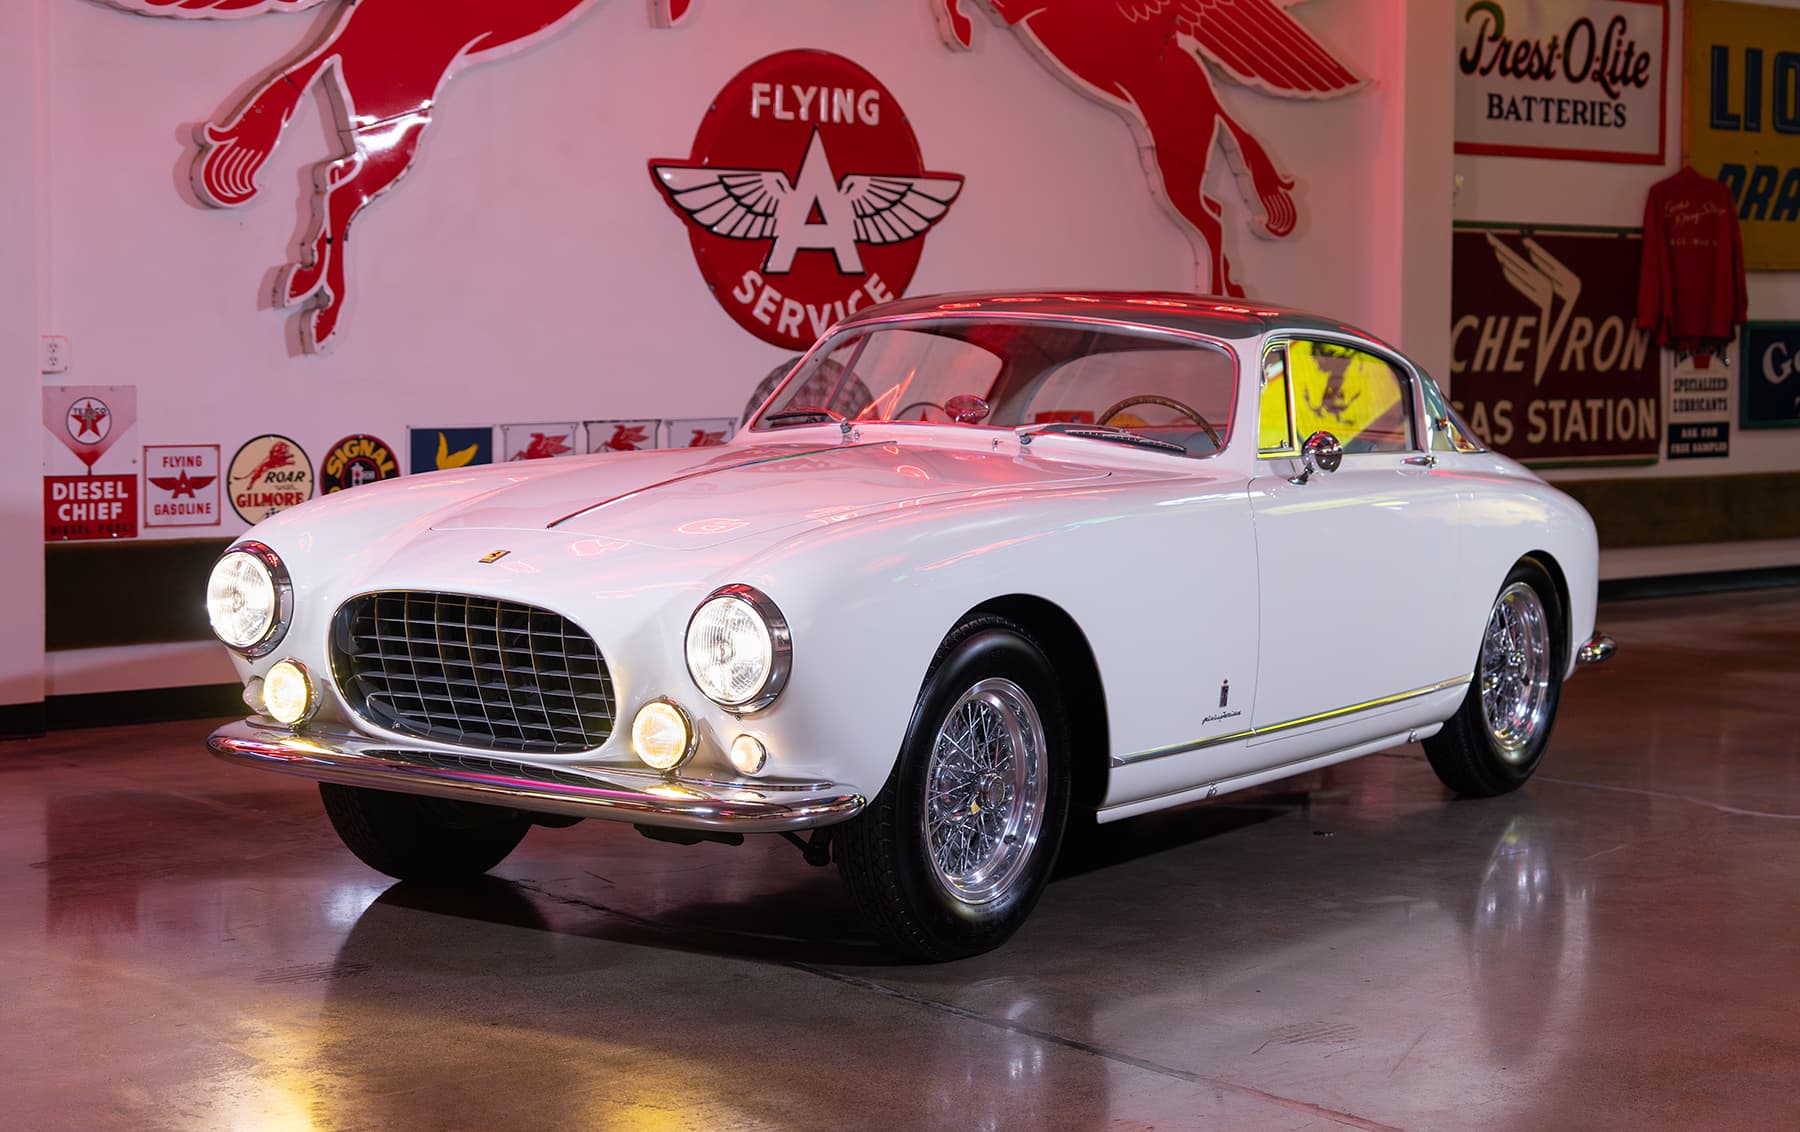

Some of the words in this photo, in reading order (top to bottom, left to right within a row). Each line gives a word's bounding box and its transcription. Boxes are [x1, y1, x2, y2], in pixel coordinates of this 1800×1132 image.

[750, 83, 881, 126] FLYING
[1486, 92, 1627, 128] BATTERIES
[764, 125, 865, 275] A
[732, 269, 894, 338] SERVICE
[1450, 312, 1653, 388] CHEVRON
[73, 407, 107, 415] TEXACO
[1452, 399, 1514, 446] AS
[1526, 396, 1657, 443] STATION
[162, 455, 203, 468] FLYING
[327, 439, 395, 479] SIGNAL
[264, 470, 306, 483] ROAR
[52, 480, 129, 501] DIESEL
[236, 492, 304, 509] GILMORE
[57, 501, 123, 522] CHIEF
[154, 502, 212, 516] GASOLINE
[50, 524, 90, 536] DIESEL
